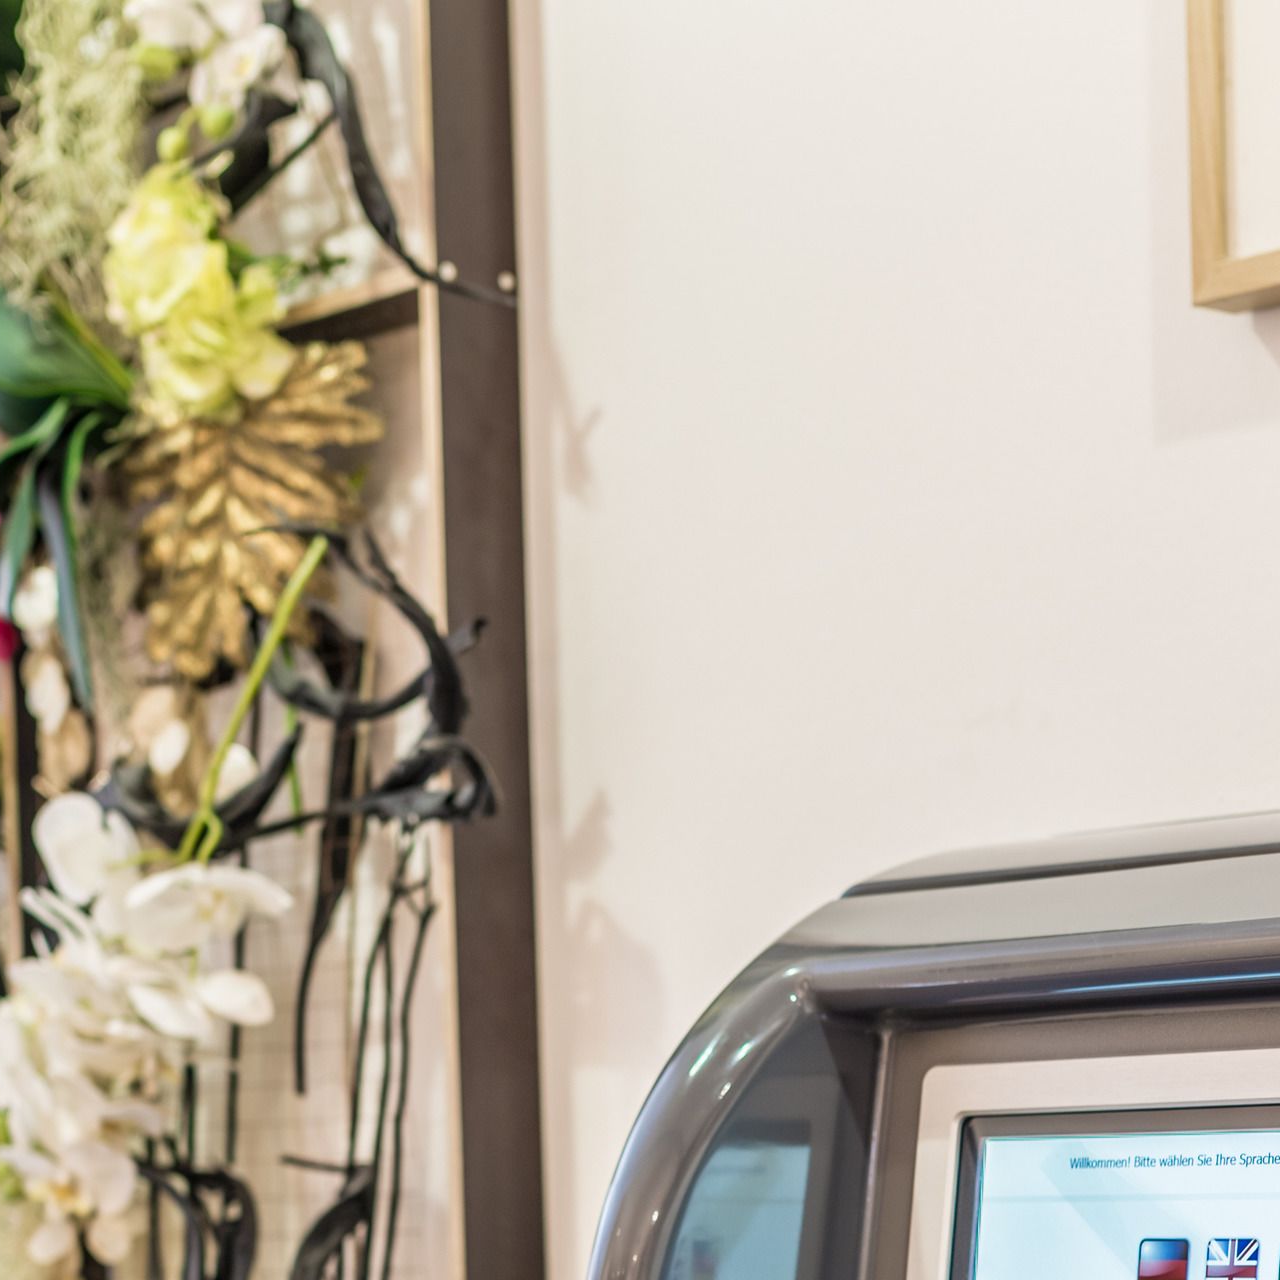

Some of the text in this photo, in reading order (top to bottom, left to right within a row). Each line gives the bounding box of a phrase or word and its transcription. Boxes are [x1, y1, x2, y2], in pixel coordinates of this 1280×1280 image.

[1070, 1152, 1280, 1169] Willkommen! Bitte wählen Sie Ihre Sprache
